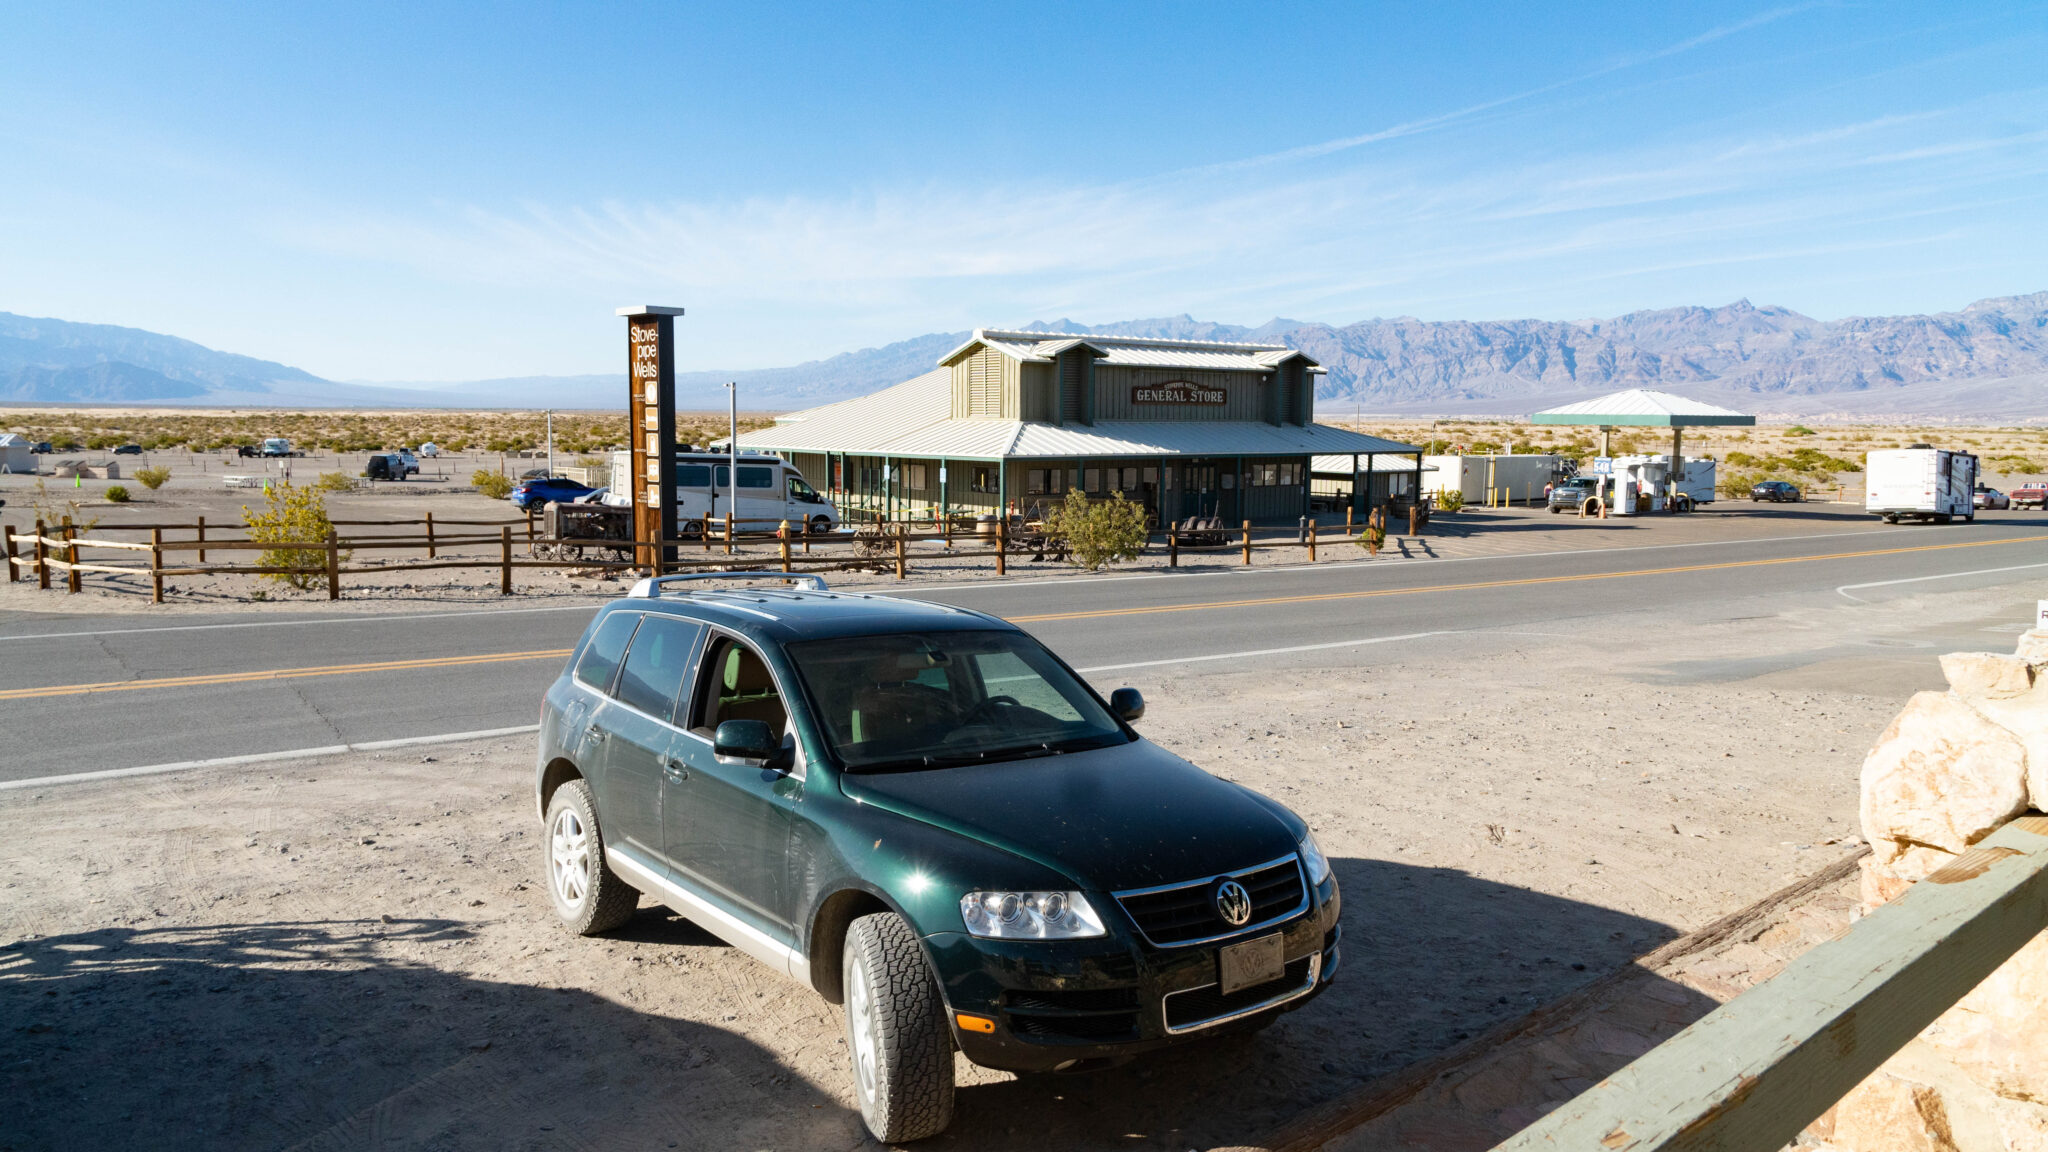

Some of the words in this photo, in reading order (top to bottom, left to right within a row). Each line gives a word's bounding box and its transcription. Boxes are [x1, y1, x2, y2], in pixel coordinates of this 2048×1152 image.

[631, 326, 659, 343] Stove-
[637, 344, 657, 361] pipe
[633, 361, 657, 378] Wells
[1137, 389, 1187, 402] GENERAL
[1190, 391, 1224, 403] STORE
